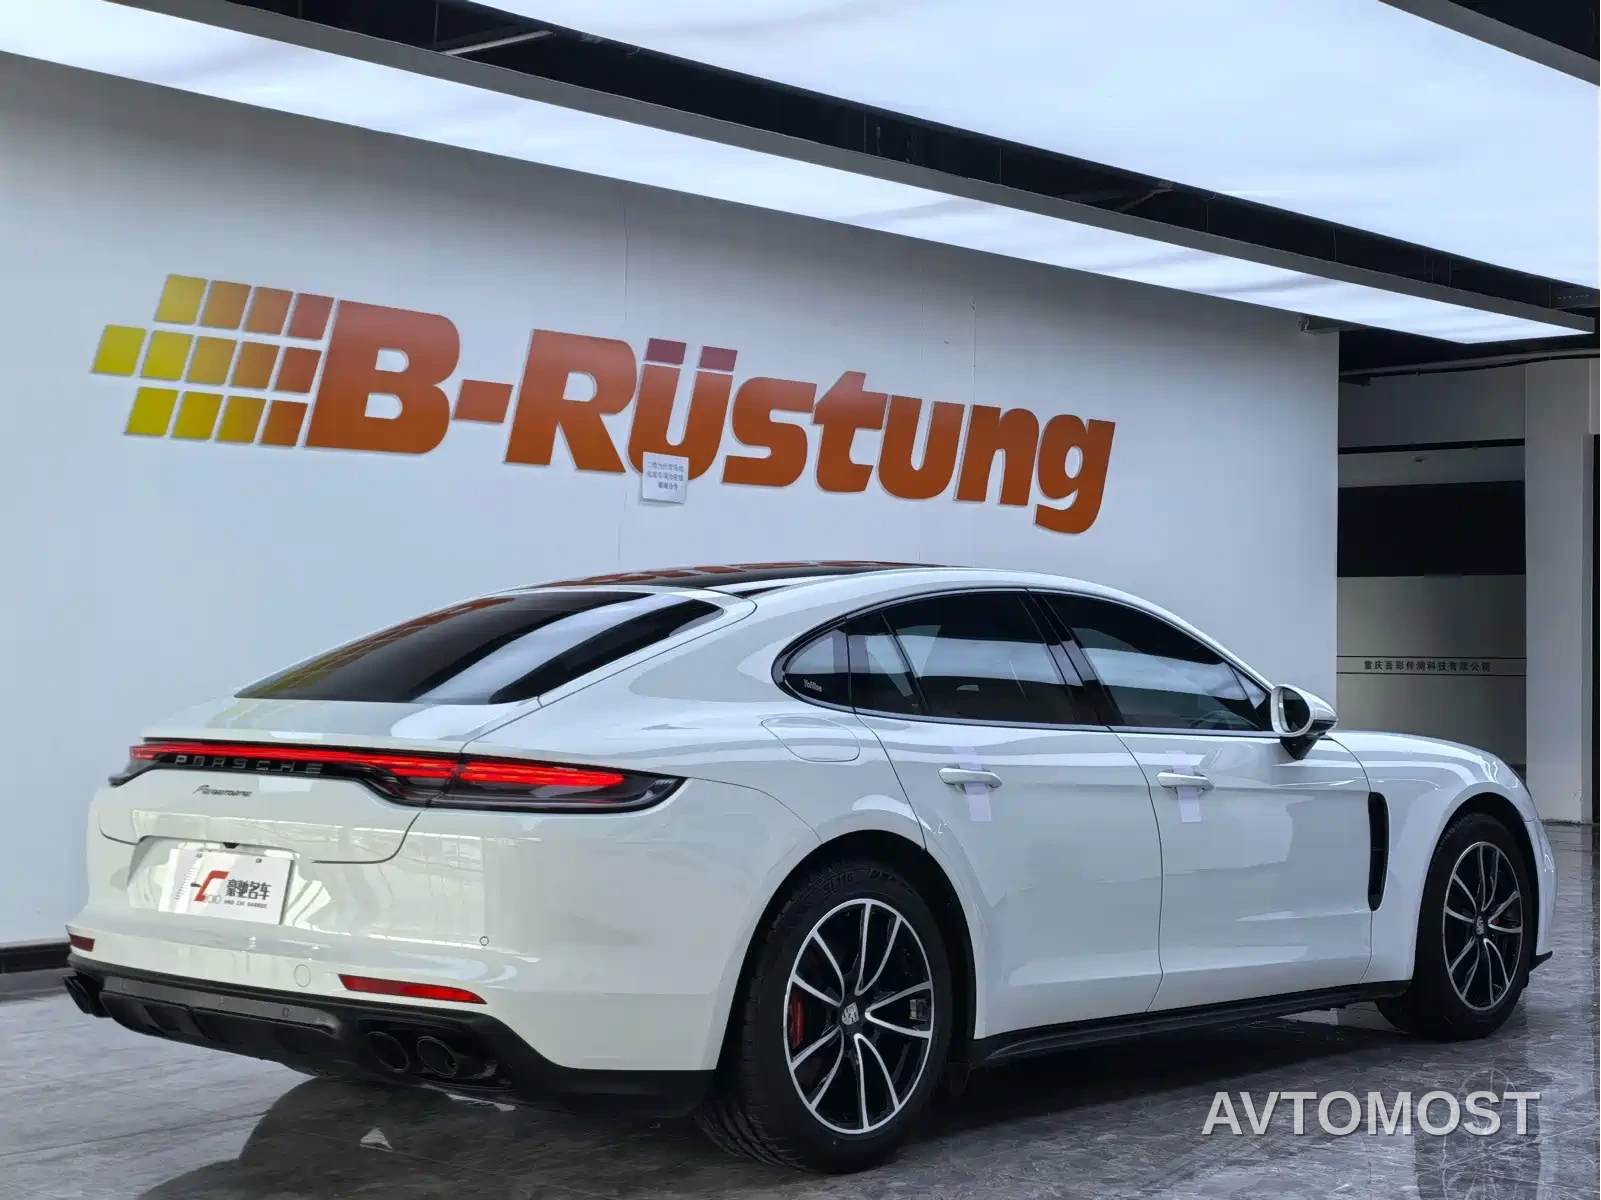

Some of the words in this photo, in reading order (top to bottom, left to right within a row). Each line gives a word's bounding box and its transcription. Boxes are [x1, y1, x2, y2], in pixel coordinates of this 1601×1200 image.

[303, 299, 1116, 535] B-Rüstung
[174, 754, 324, 775] PORSCHE
[225, 879, 271, 900] 豪驰名车
